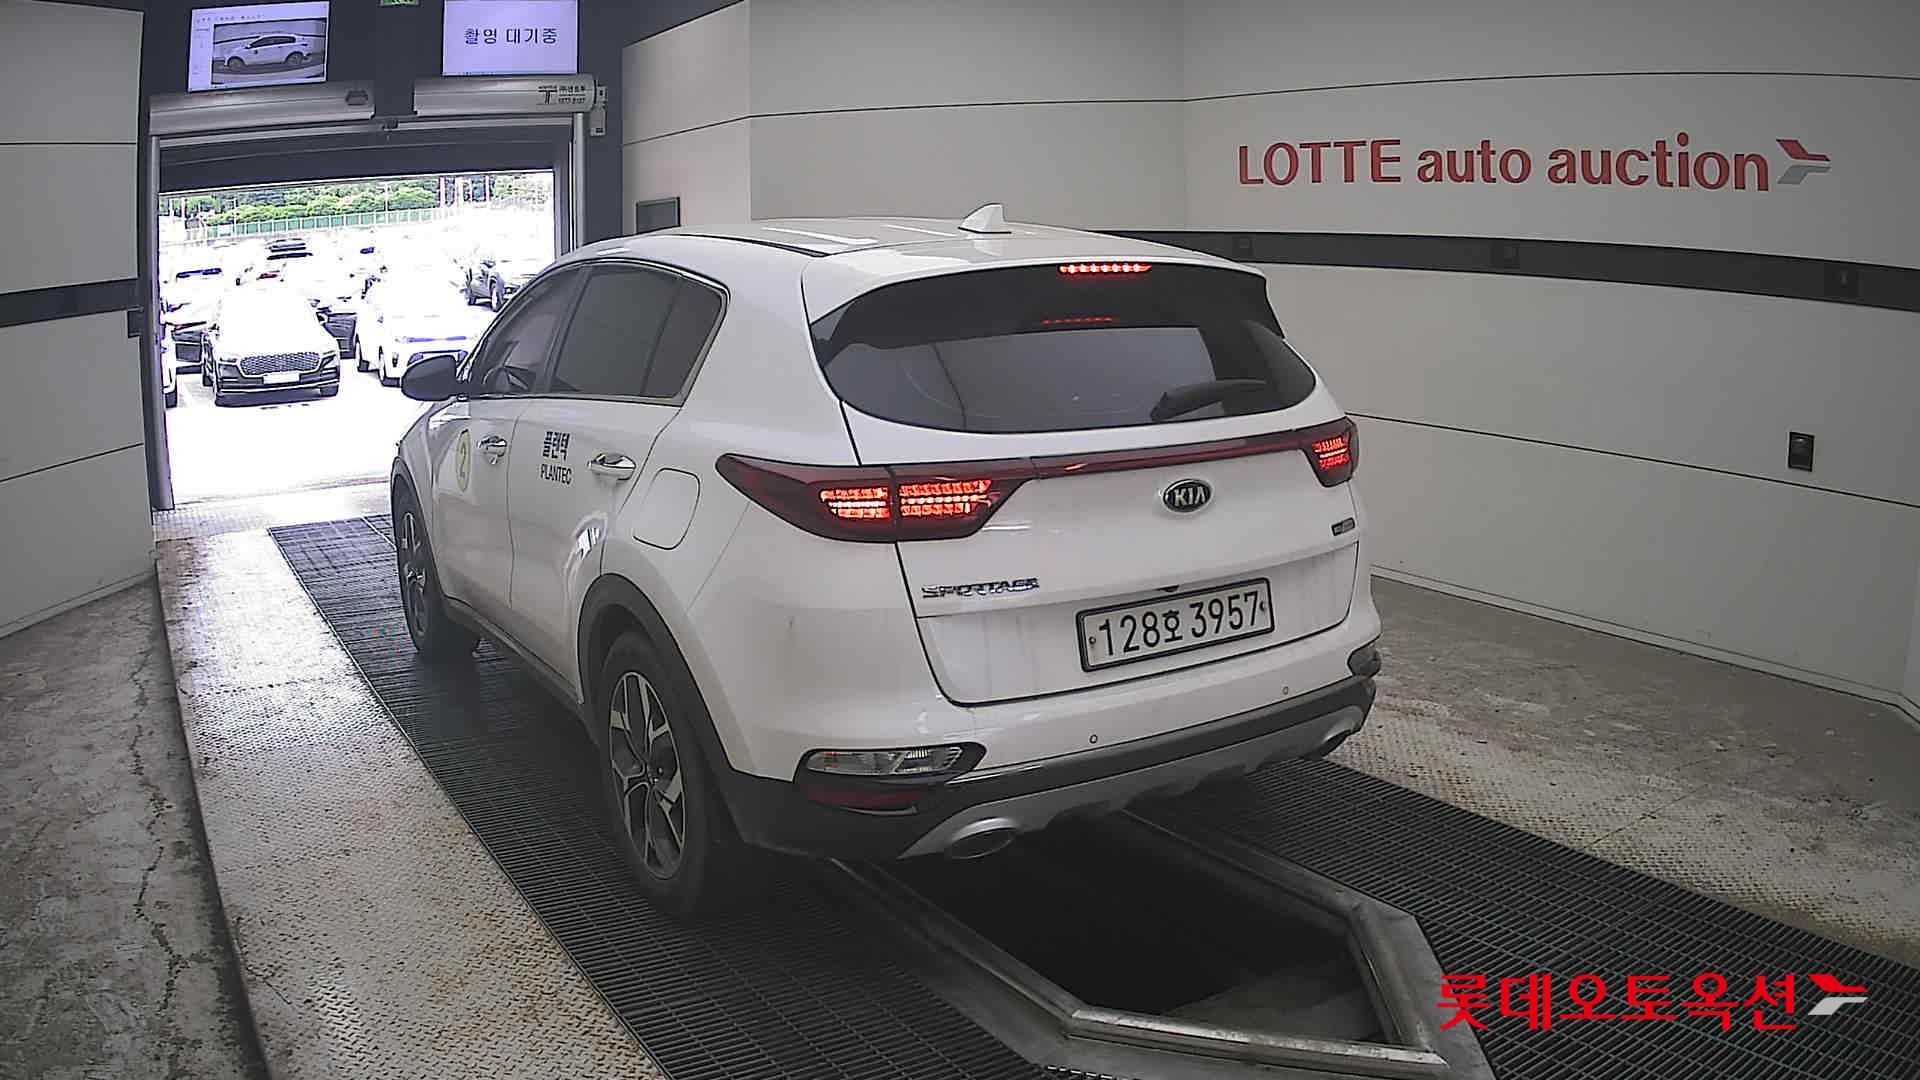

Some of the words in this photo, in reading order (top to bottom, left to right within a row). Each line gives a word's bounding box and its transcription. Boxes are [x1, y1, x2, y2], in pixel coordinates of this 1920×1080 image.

[465, 28, 497, 45] 촬영
[506, 28, 557, 45] 대기중
[1239, 140, 1401, 185] LOTTE
[1417, 140, 1532, 184] auto
[1547, 132, 1770, 192] auction
[540, 463, 572, 485] PLANTEC
[1174, 486, 1206, 507] KIA
[1099, 609, 1183, 656] 128호
[1189, 590, 1258, 638] 3957
